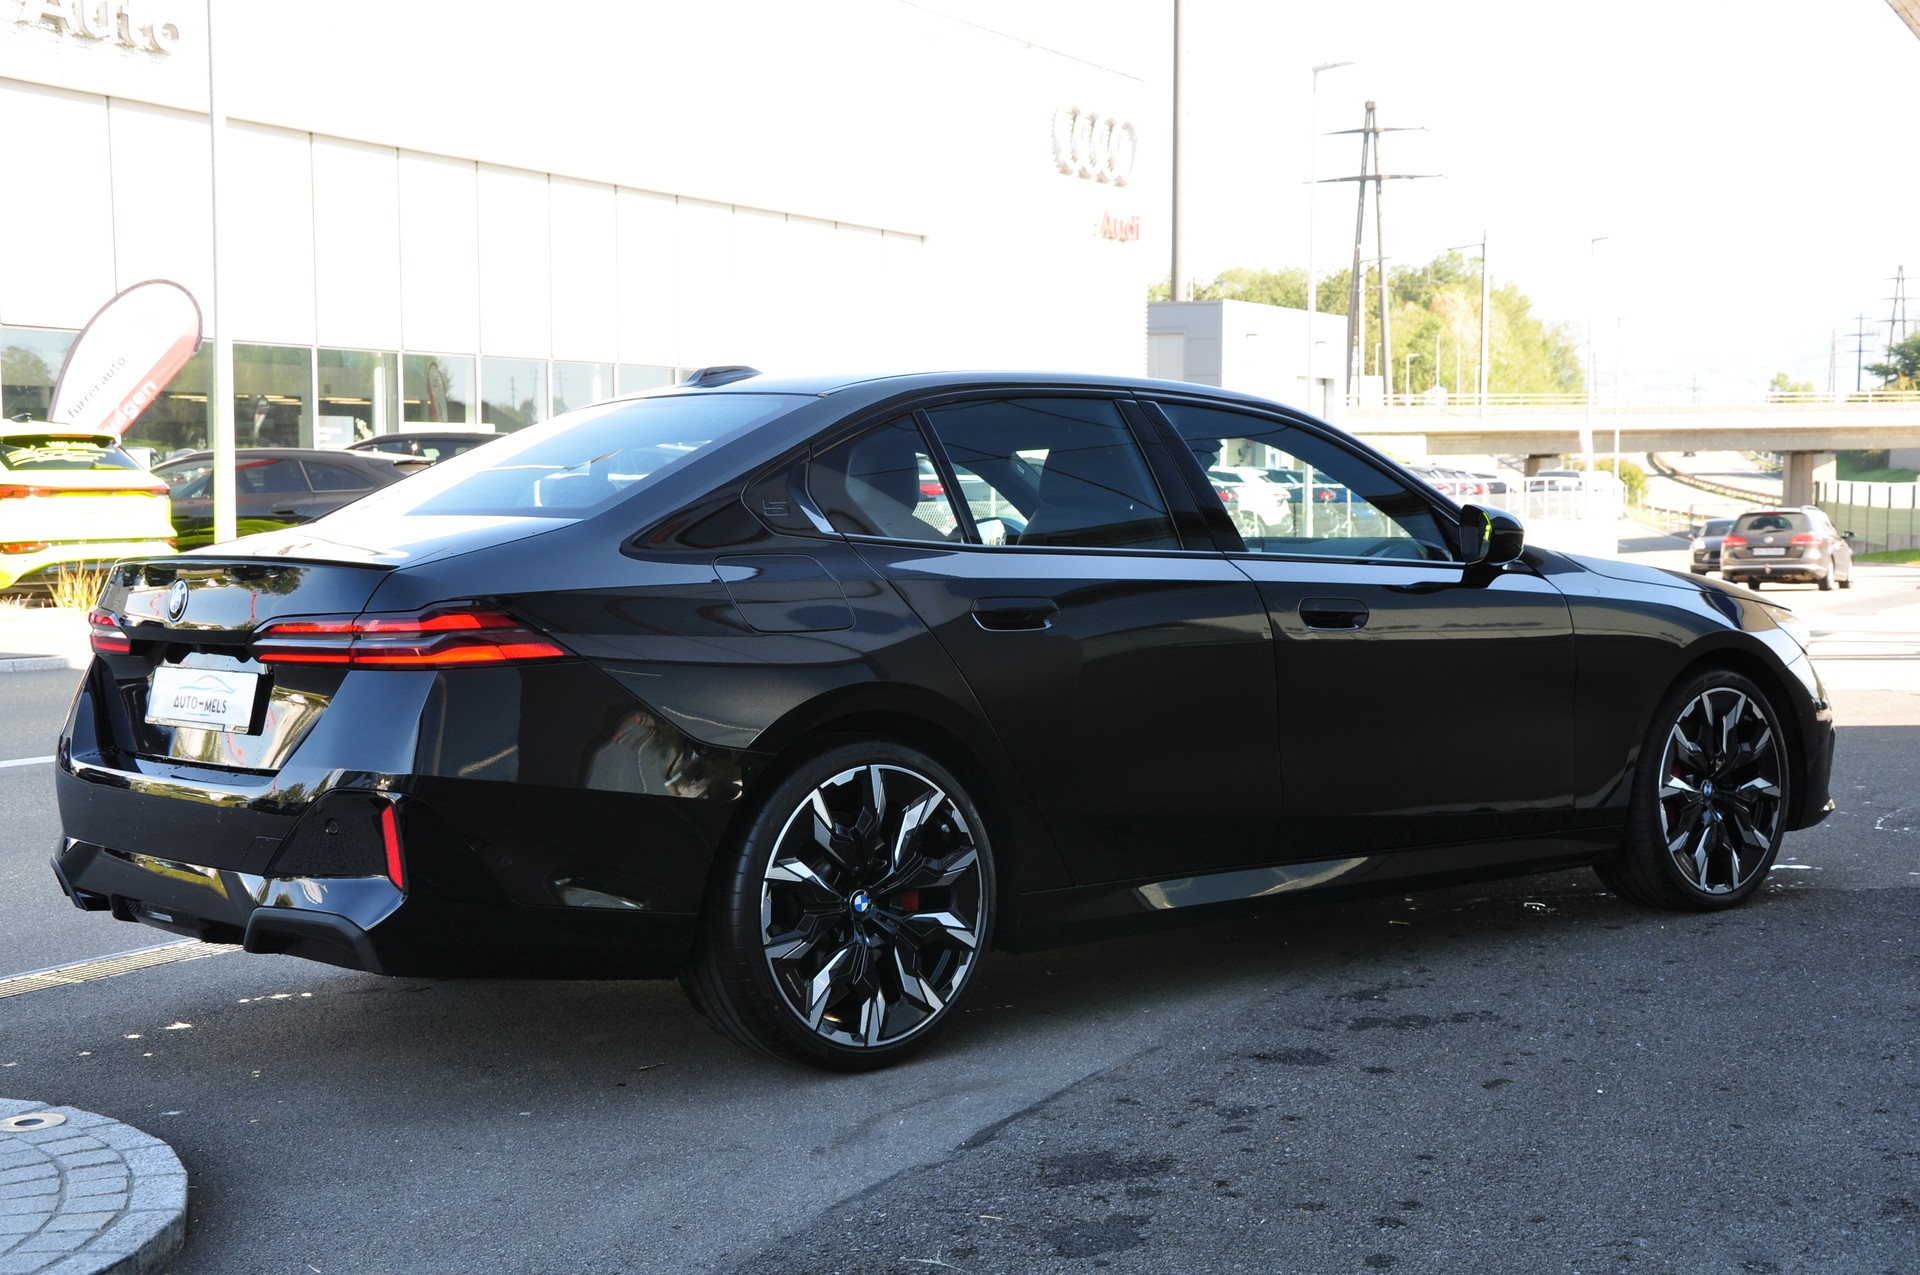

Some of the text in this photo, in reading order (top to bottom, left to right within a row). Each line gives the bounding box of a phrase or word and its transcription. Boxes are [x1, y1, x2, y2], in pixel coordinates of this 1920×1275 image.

[1099, 209, 1140, 241] Audi
[67, 357, 126, 418] furrer auto
